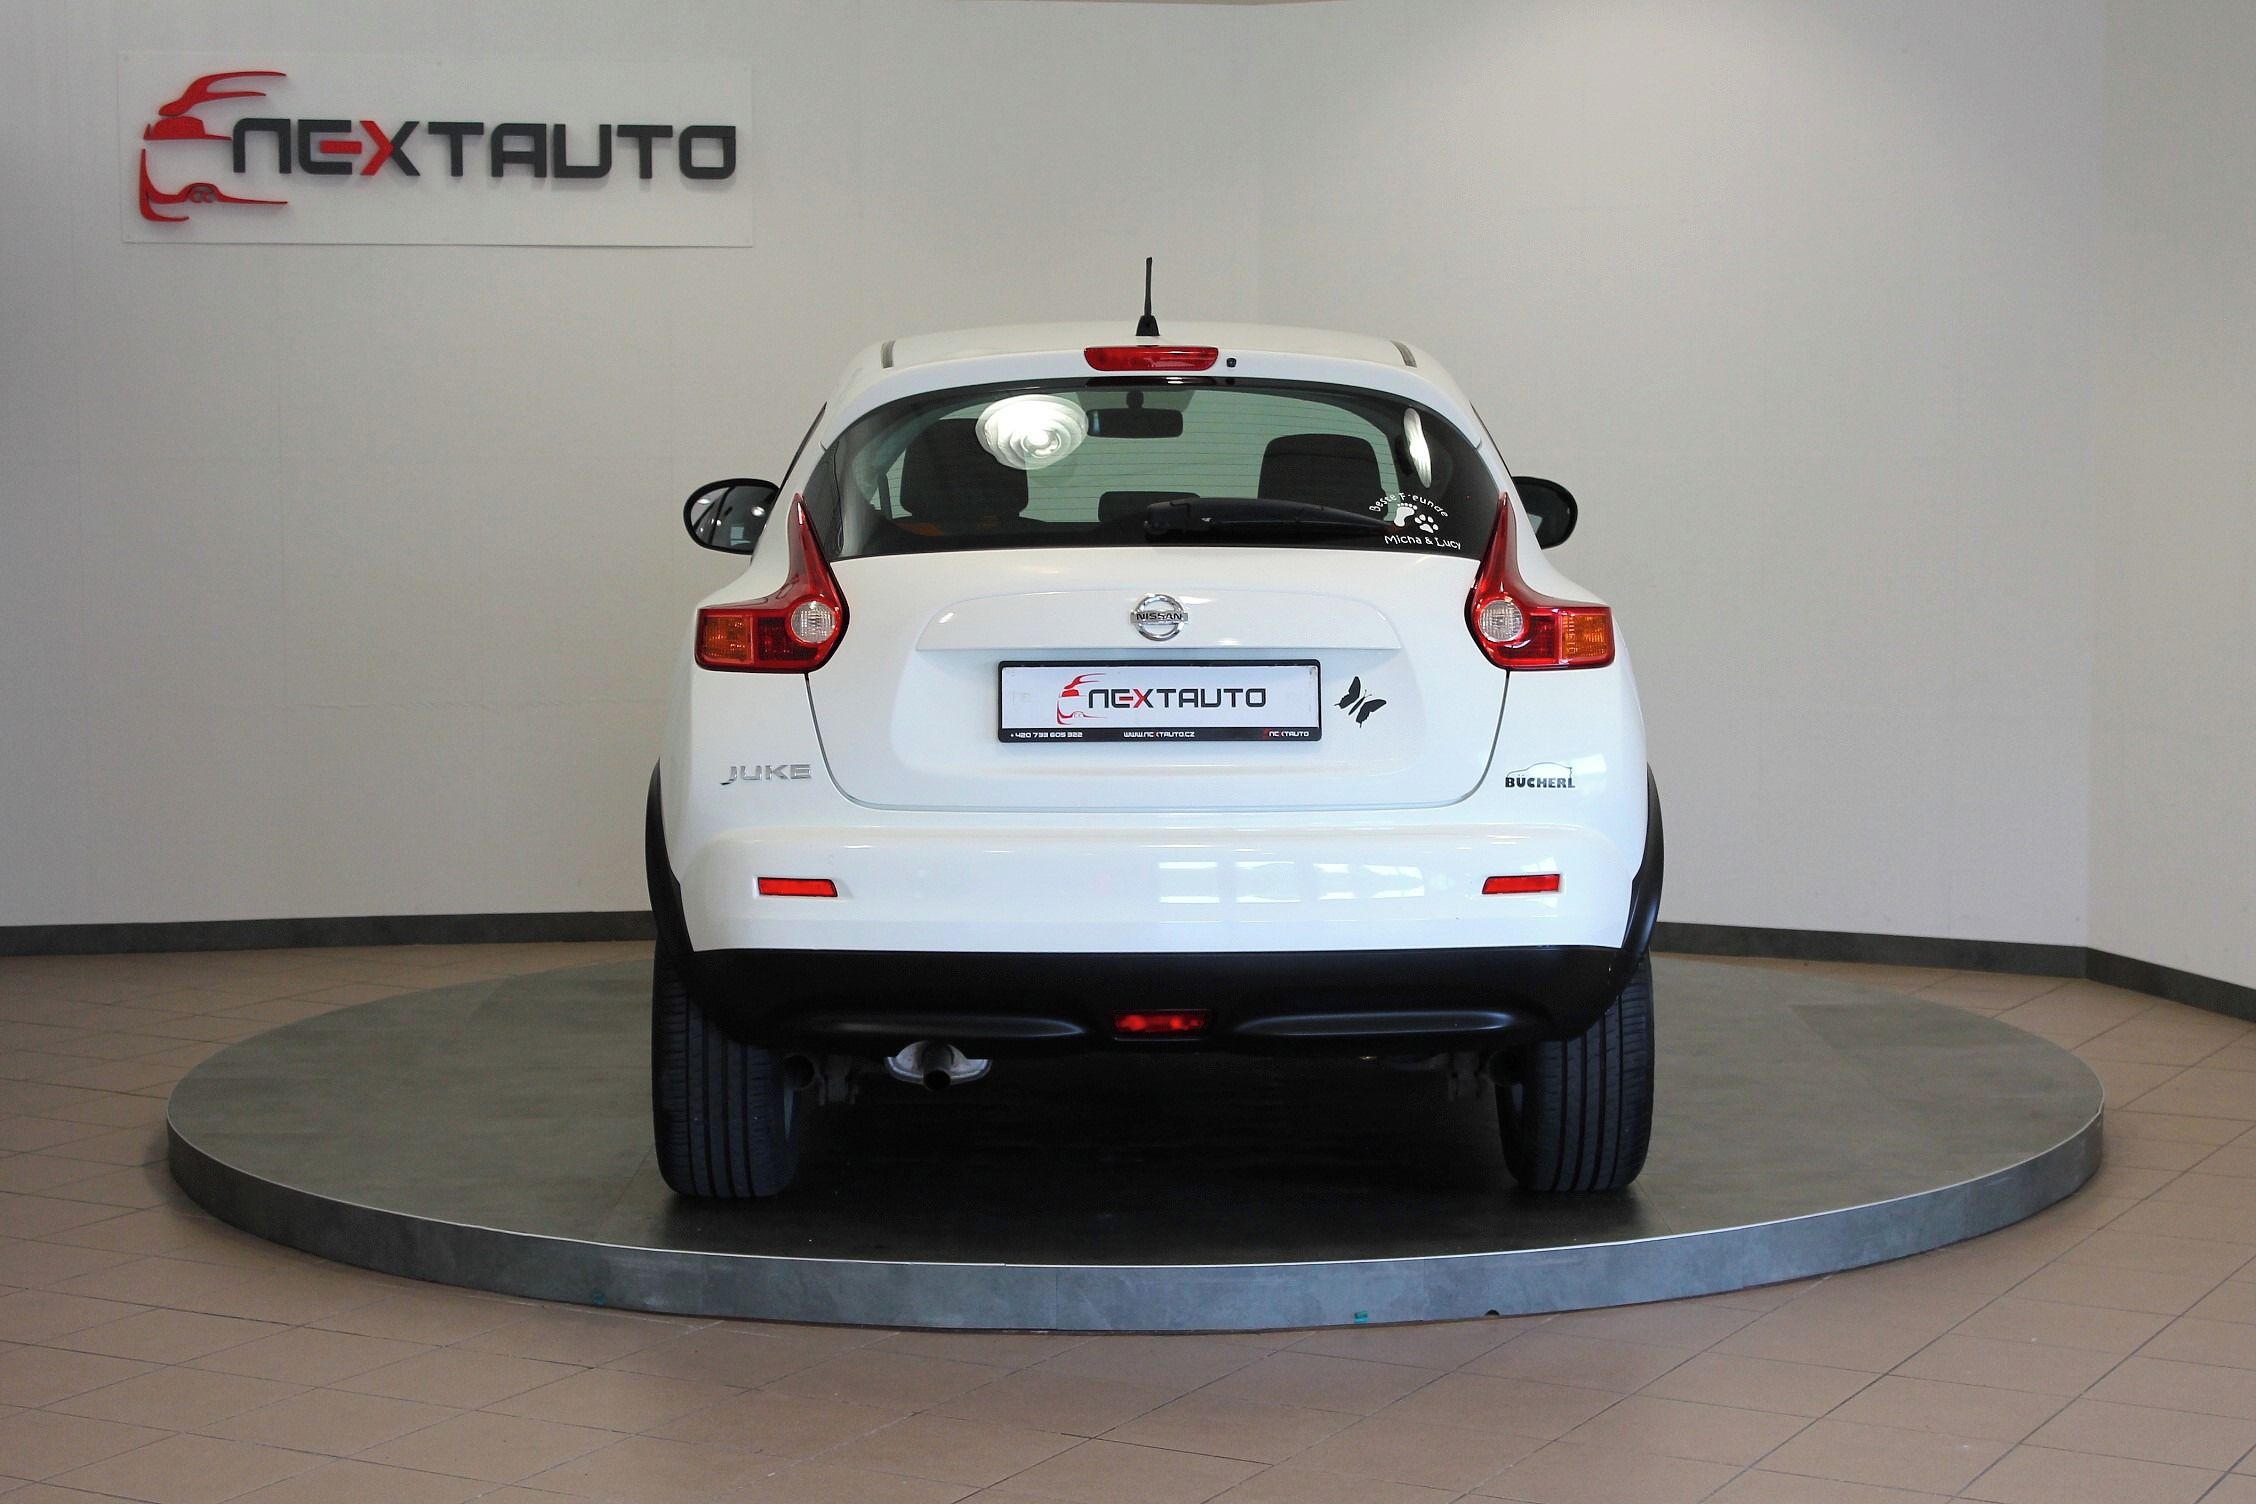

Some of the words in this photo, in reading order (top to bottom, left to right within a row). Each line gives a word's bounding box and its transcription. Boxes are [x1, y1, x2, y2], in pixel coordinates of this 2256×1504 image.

[232, 117, 737, 180] NEXTAUTO
[1398, 492, 1449, 518] Feunde
[1384, 534, 1423, 545] Micha
[1424, 536, 1434, 546] &
[1434, 536, 1462, 551] Lucy
[1136, 612, 1183, 621] NISSAN
[1088, 688, 1267, 710] NEXTAUTO
[720, 764, 812, 786] JUKE
[1504, 774, 1576, 789] BÜCHERL
